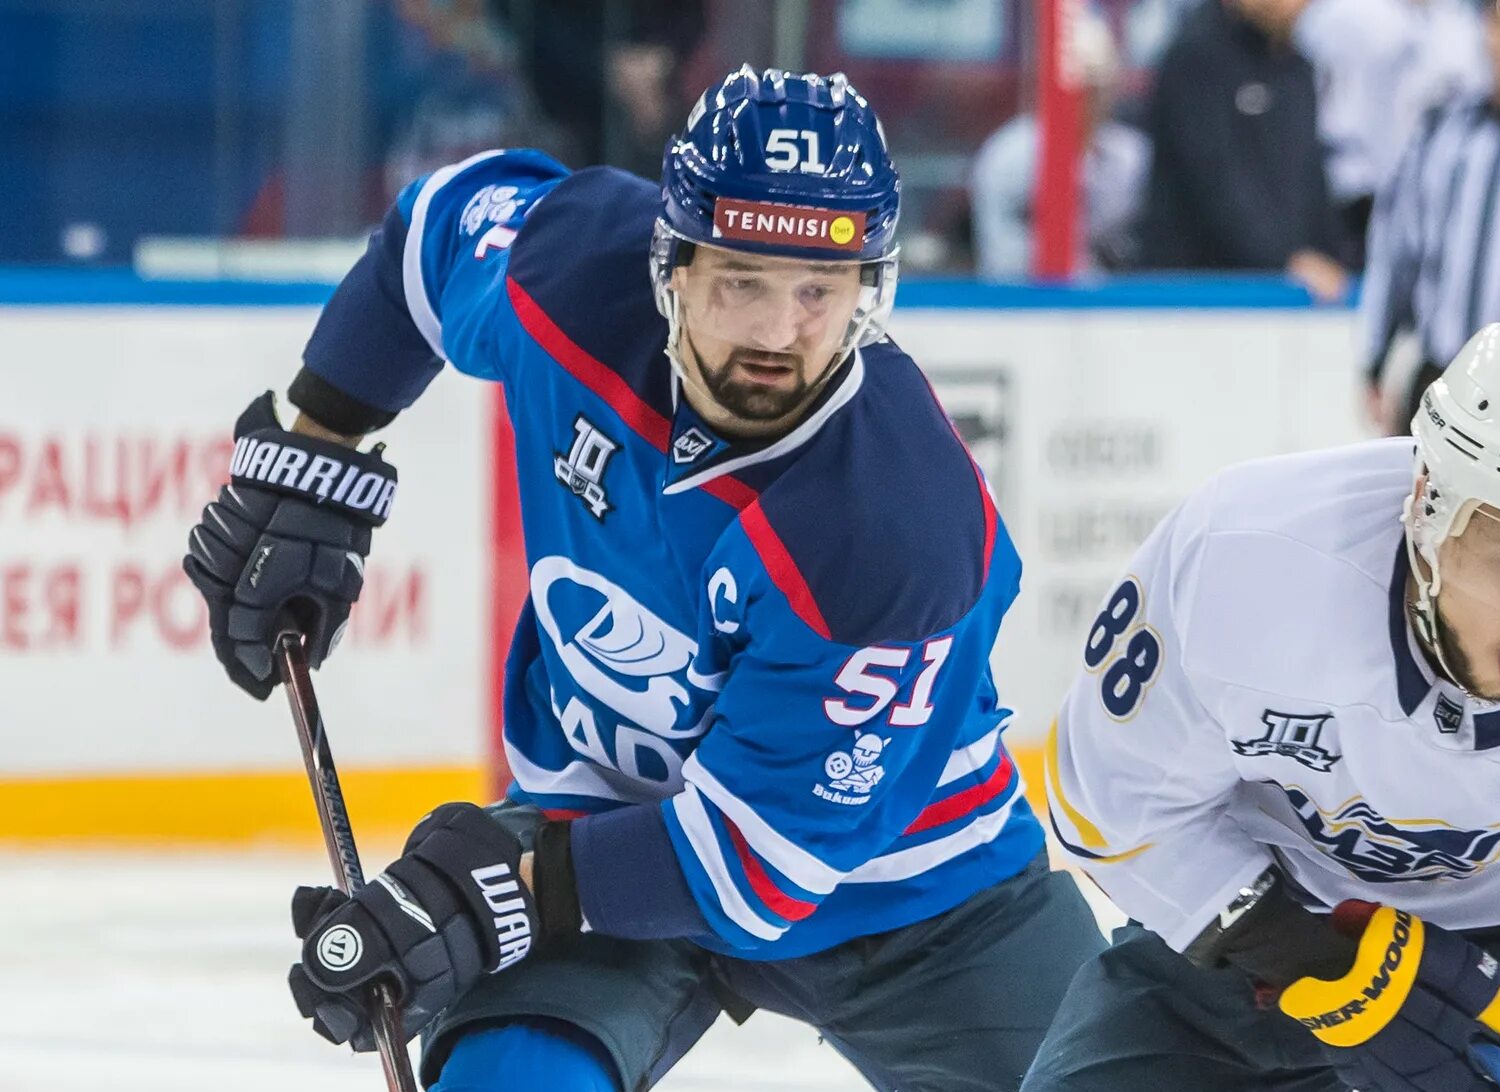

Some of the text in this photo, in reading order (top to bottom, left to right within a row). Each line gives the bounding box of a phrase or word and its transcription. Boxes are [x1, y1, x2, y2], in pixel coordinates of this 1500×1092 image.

[765, 129, 826, 174] 51
[724, 209, 829, 239] TENNISI
[229, 436, 398, 519] WARRIOR
[708, 567, 739, 634] C
[822, 636, 955, 728] 51
[1083, 578, 1161, 719] 88
[470, 862, 533, 975] WAR
